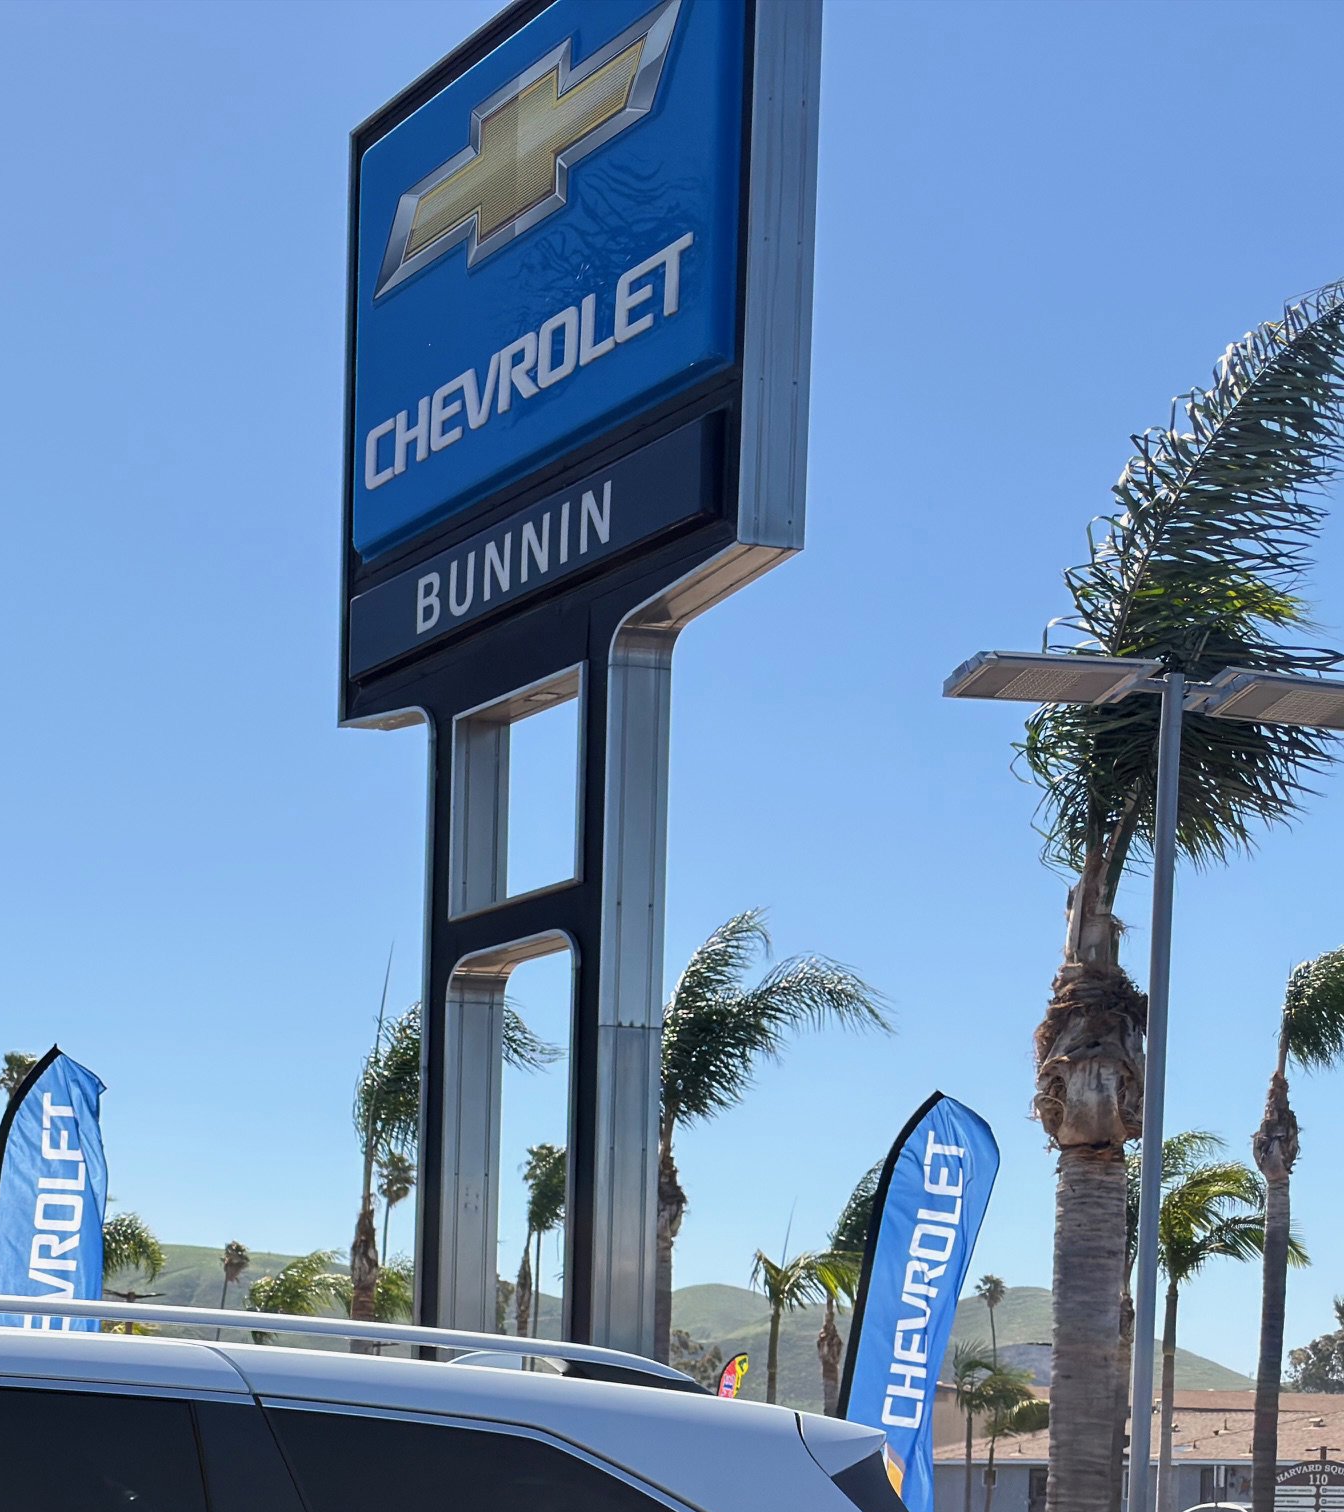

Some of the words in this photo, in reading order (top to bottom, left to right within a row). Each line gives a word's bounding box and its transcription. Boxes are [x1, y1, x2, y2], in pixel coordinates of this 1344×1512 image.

[363, 231, 694, 491] CHEVROLET
[415, 480, 612, 635] BUNNIN
[881, 1130, 965, 1429] CHEVROLET
[1276, 1464, 1322, 1483] HARVARD
[1324, 1465, 1344, 1476] SQU
[1309, 1474, 1328, 1485] 110
